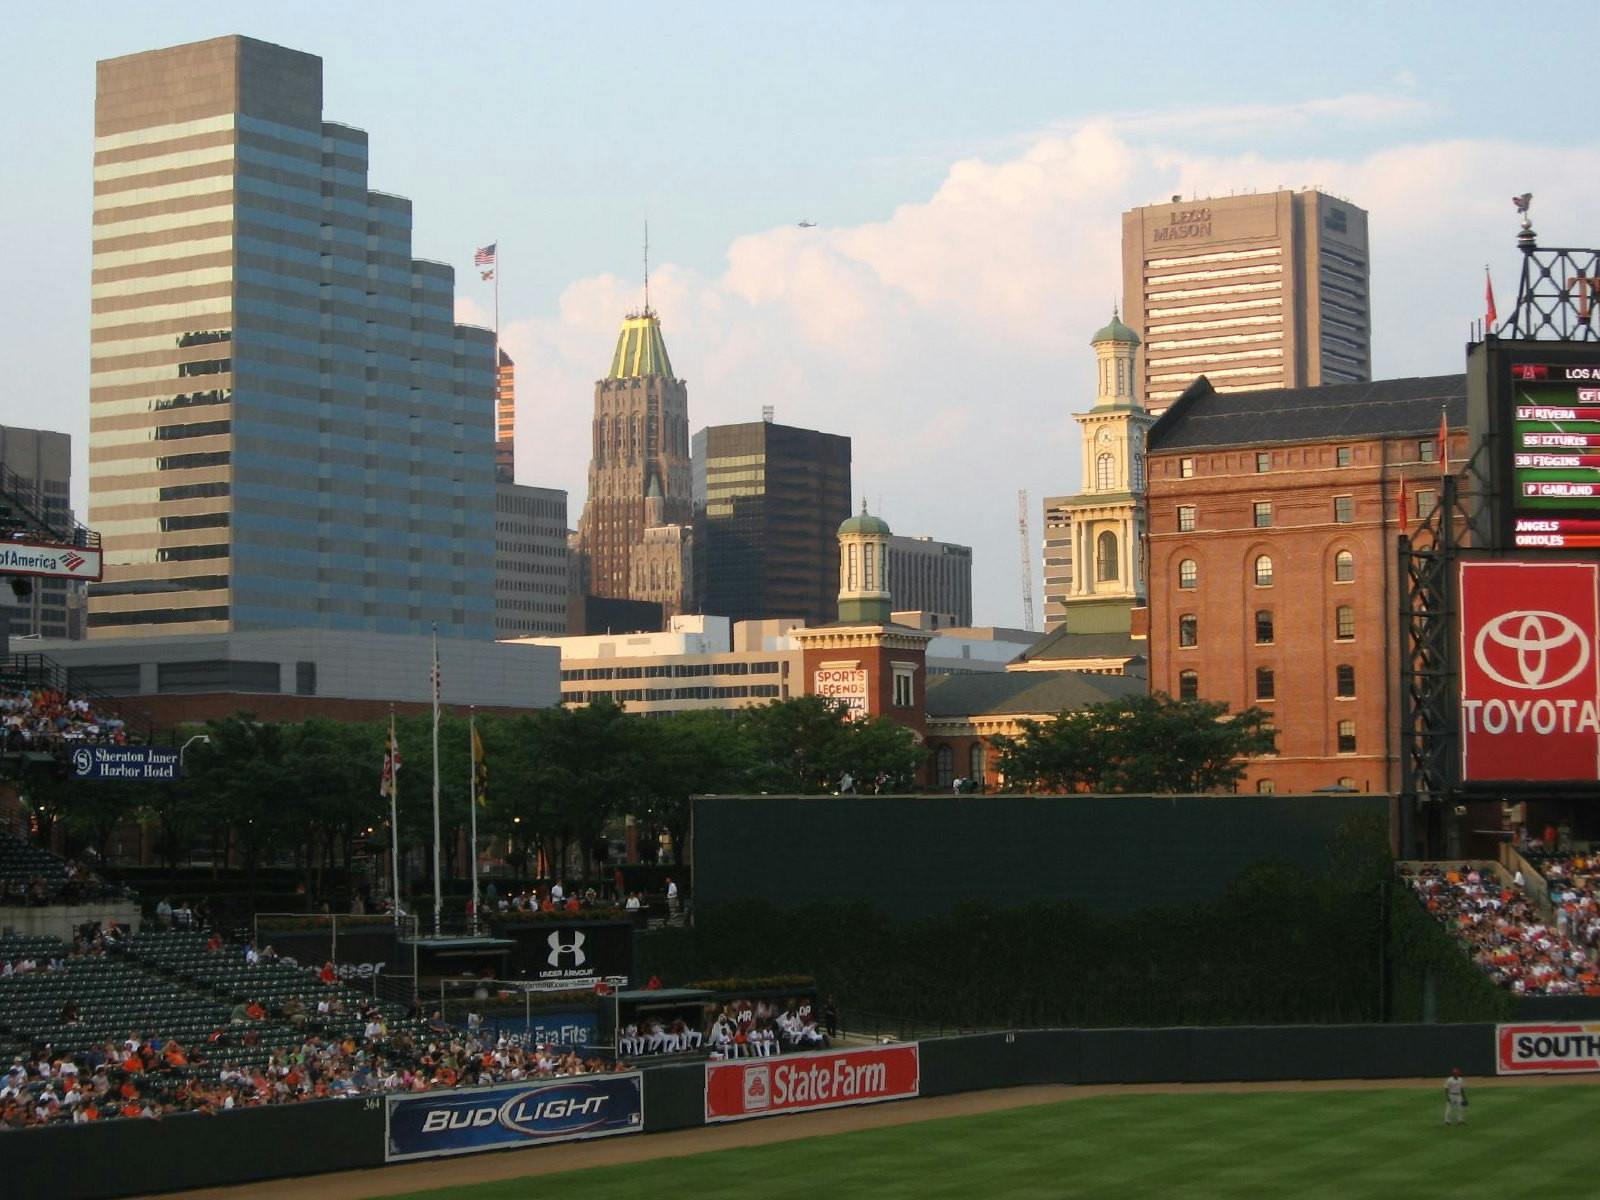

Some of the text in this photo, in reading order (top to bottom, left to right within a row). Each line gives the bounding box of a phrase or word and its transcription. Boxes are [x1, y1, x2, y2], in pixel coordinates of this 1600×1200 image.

[1170, 207, 1212, 225] LEGG
[1153, 223, 1212, 242] MASON
[1566, 368, 1590, 379] LOS
[1579, 391, 1594, 402] CF
[1518, 409, 1576, 420] LF RIVERA
[1523, 435, 1588, 446] SS IZTURIS
[1516, 455, 1580, 466] 3B FIGGINS
[1527, 484, 1593, 496] P GARLAND
[1516, 521, 1560, 532] ANGELS
[1516, 536, 1564, 546] ORIOLES
[11, 551, 57, 570] America
[818, 671, 864, 682] SPORTS
[818, 684, 864, 695] LEGENDS
[1464, 698, 1600, 735] TOYOTA
[95, 748, 178, 764] Sheraton Inner
[100, 763, 173, 778] Harbor Hotel
[539, 968, 594, 978] UNDER ARMOUR
[561, 1023, 588, 1044] Fits
[1517, 1035, 1600, 1059] SOUTH
[363, 1097, 380, 1111] 364
[421, 1095, 609, 1133] BUD LIGHT
